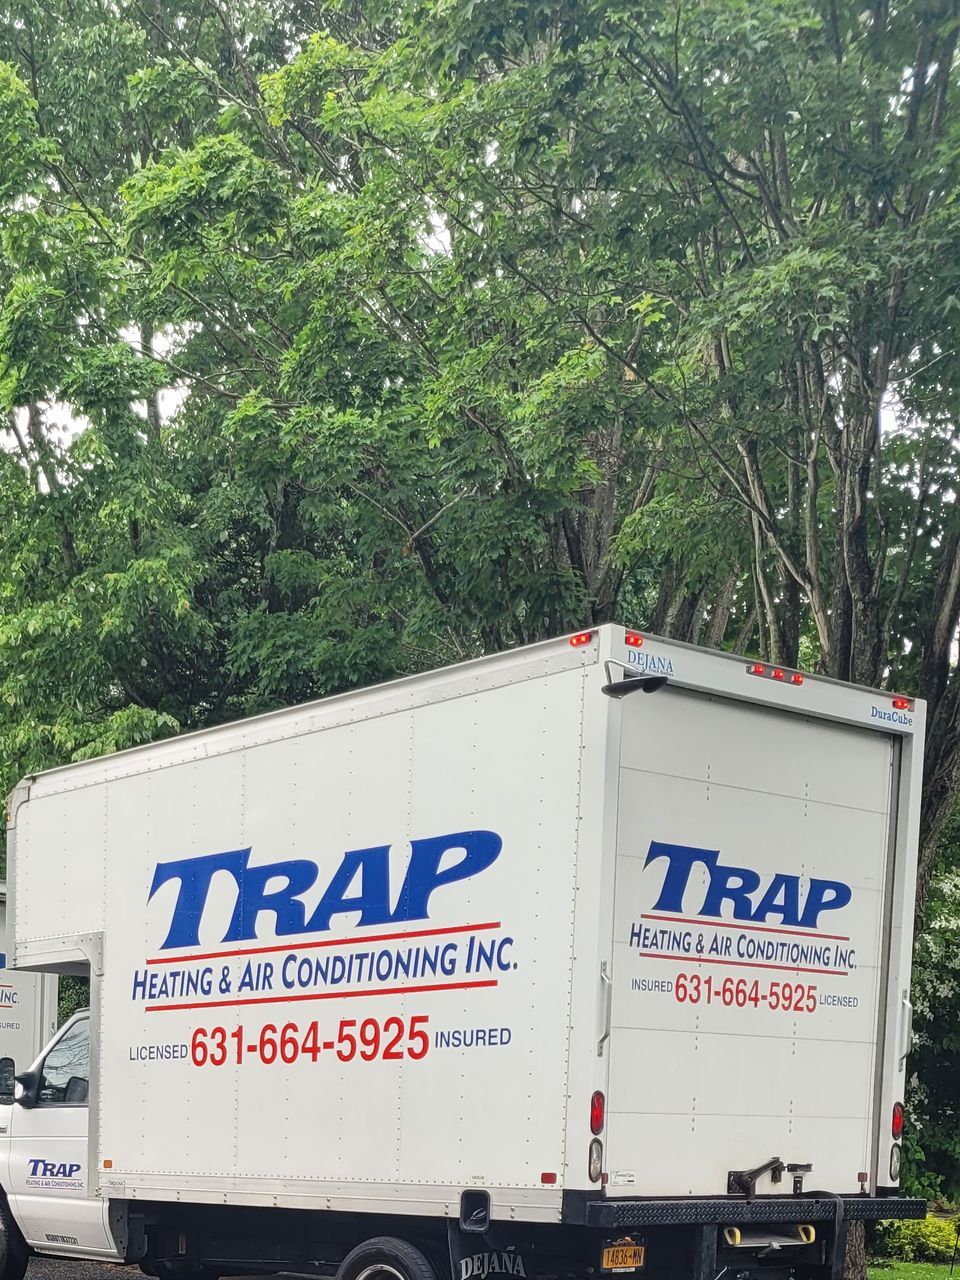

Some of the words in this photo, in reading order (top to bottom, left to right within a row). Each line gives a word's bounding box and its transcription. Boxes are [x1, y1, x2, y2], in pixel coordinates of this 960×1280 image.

[627, 649, 673, 673] DEJANA
[871, 706, 913, 726] DuraCube
[146, 830, 503, 950] TRAP
[642, 840, 852, 929] TRAP
[630, 923, 691, 953] HEATING
[696, 934, 705, 954] &
[708, 931, 732, 956] AIR
[737, 934, 830, 967] CONDITIONING
[833, 945, 857, 969] INC.
[132, 966, 212, 1000] HEATING
[218, 968, 232, 994] &
[238, 959, 274, 992] AIR
[282, 943, 458, 989] CONDITIONING
[465, 936, 518, 973] INC.
[0, 989, 20, 1004] INC.
[631, 978, 673, 993] INSURED
[675, 973, 817, 1013] 631-664-5925
[819, 994, 858, 1008] LICENSED
[129, 1044, 188, 1061] LICENSED
[191, 1015, 430, 1067] 631-664-5925
[435, 1028, 512, 1049] INSURED
[27, 1159, 81, 1177] TRAP
[460, 1252, 527, 1280] DEJANA
